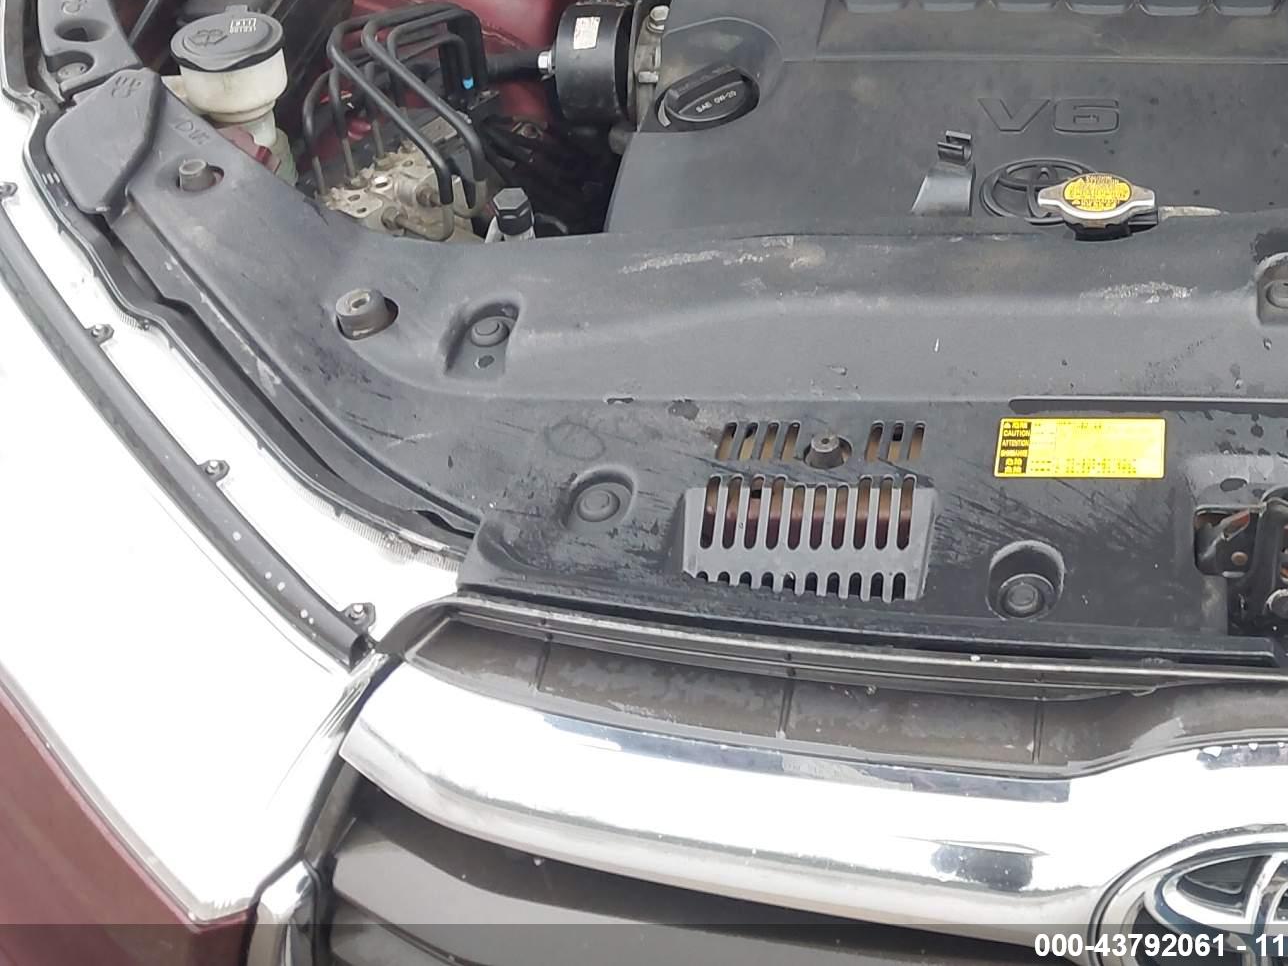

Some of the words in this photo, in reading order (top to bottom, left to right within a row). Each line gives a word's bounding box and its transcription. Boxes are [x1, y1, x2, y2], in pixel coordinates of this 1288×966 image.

[695, 101, 713, 113] SAE
[978, 97, 1120, 135] V6
[1003, 429, 1031, 437] CAUTION
[1002, 439, 1030, 447] ATTENTION
